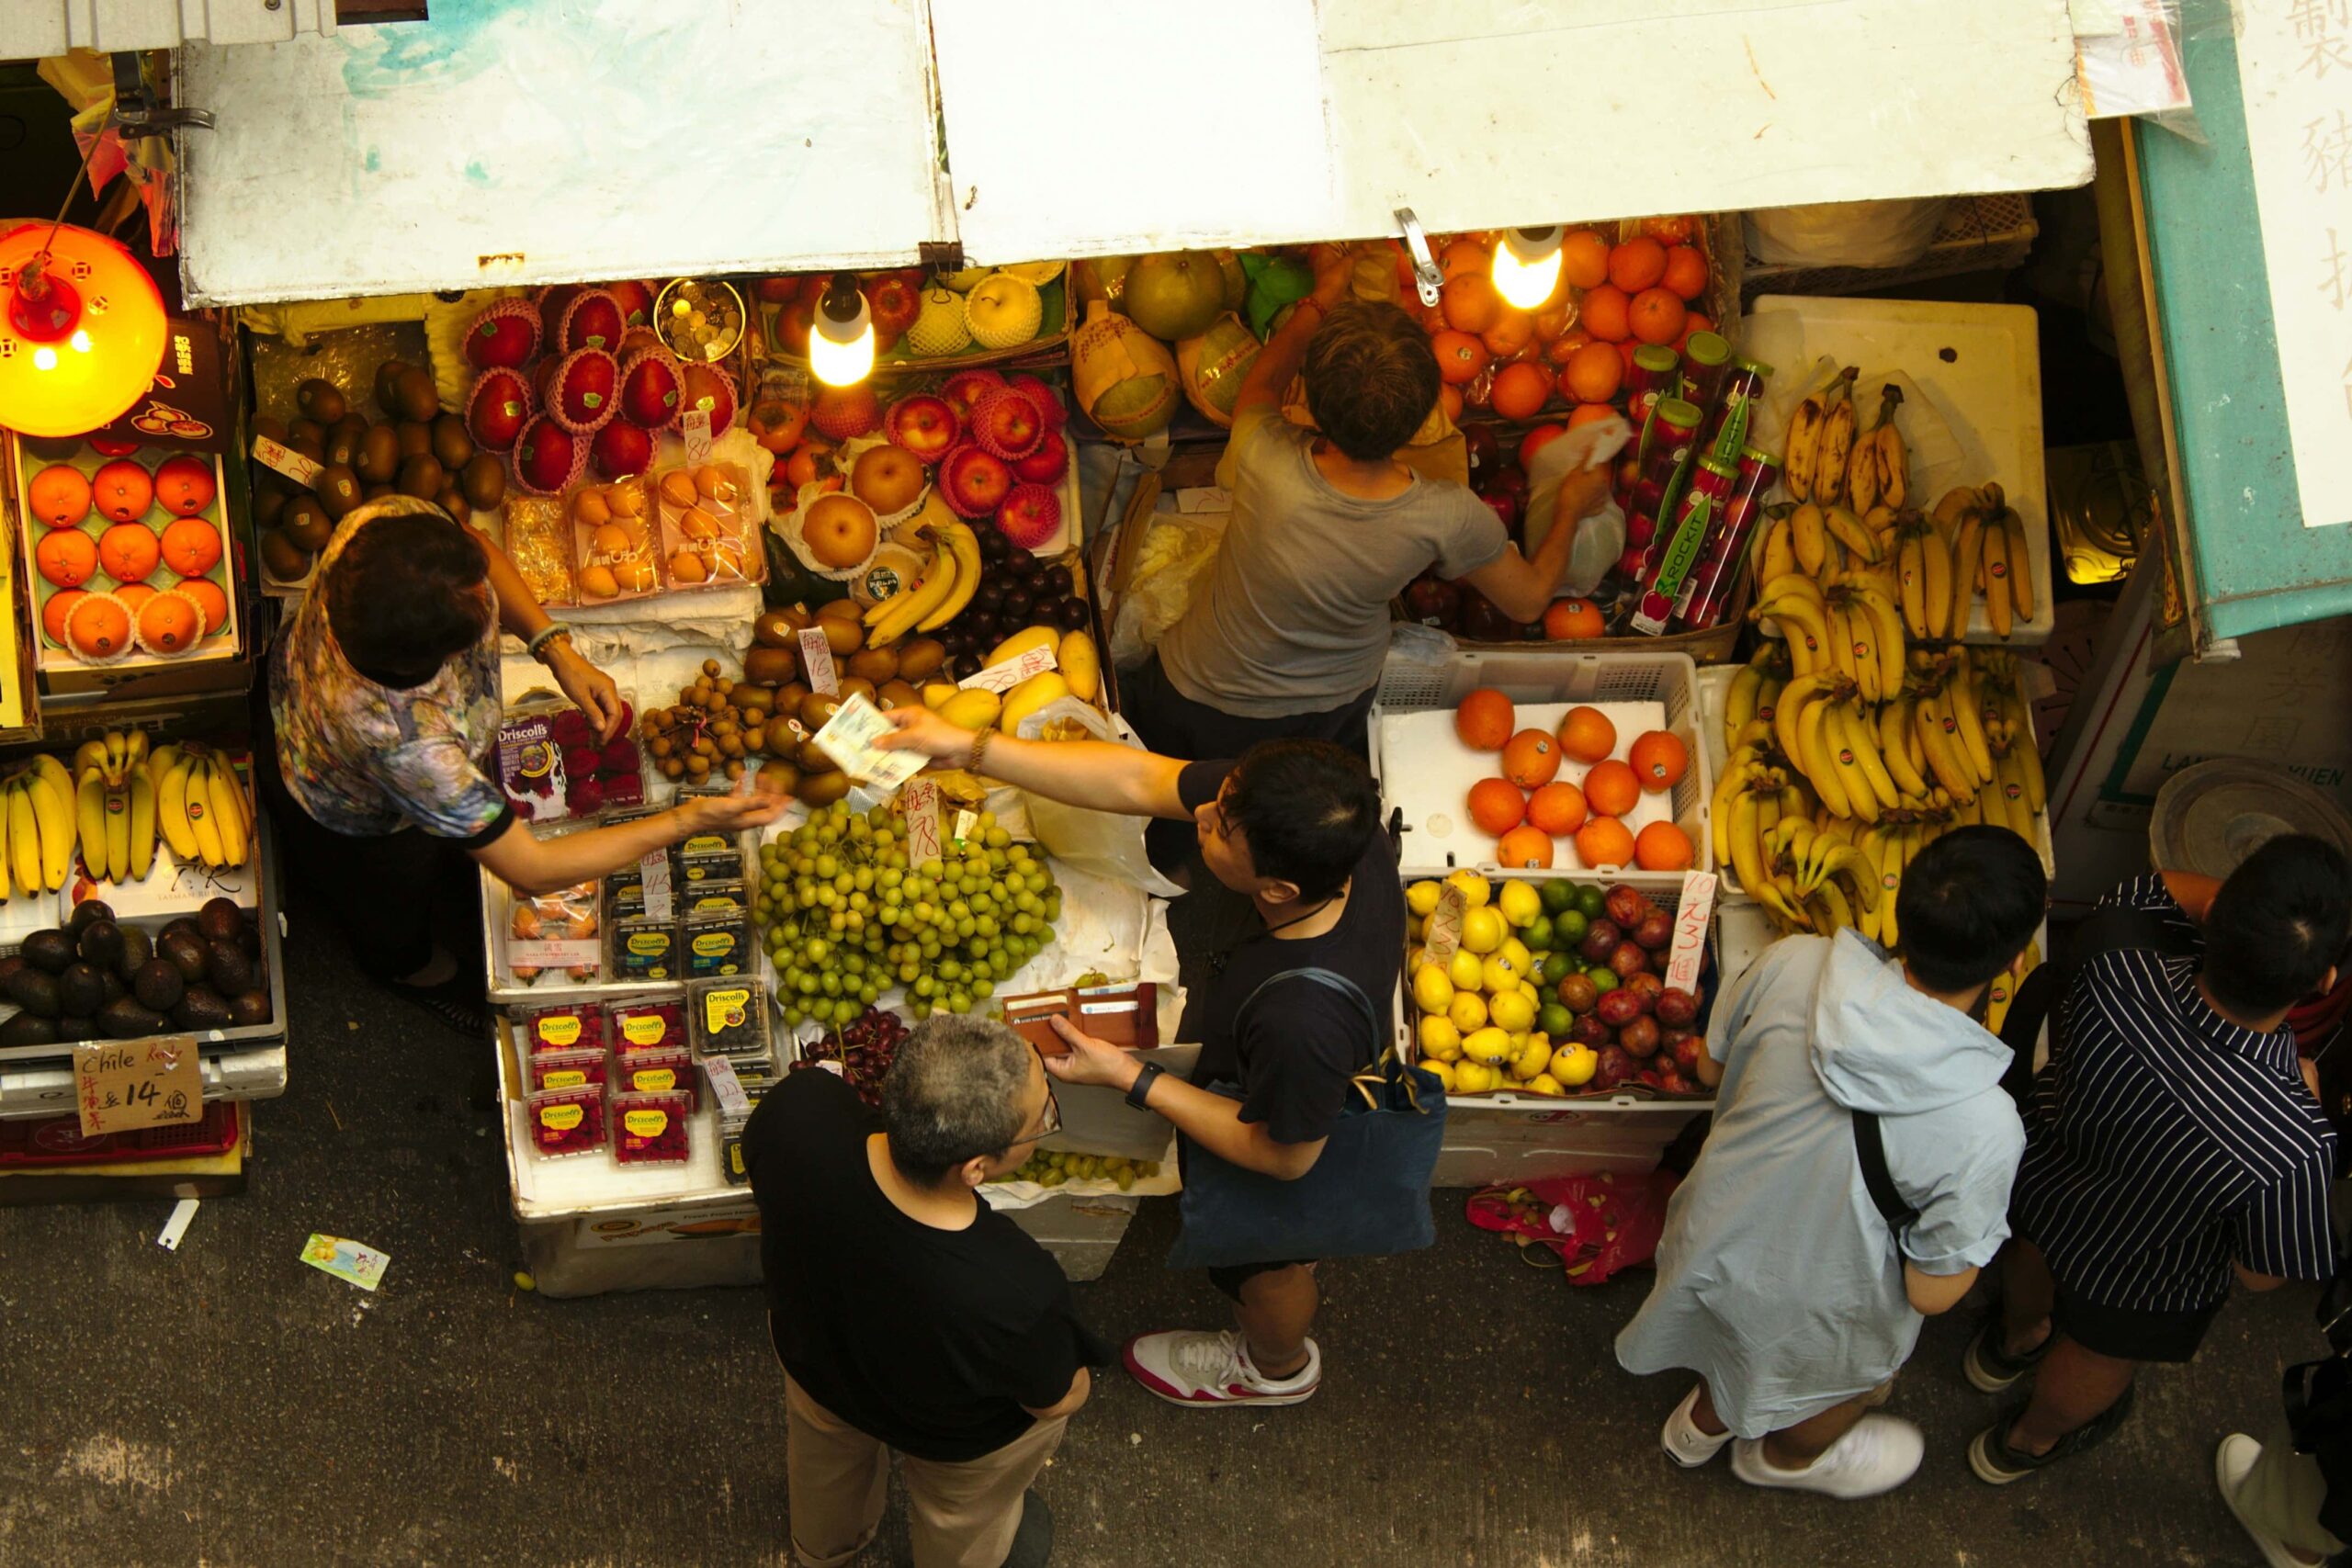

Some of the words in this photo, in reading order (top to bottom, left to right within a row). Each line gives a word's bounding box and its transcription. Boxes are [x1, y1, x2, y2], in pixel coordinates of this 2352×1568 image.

[1666, 514, 1703, 580] ROCKIT
[811, 657, 831, 677] 16
[497, 723, 548, 743] Driscoll's
[708, 991, 745, 1003] Driscoll's
[82, 1049, 135, 1074] Chile
